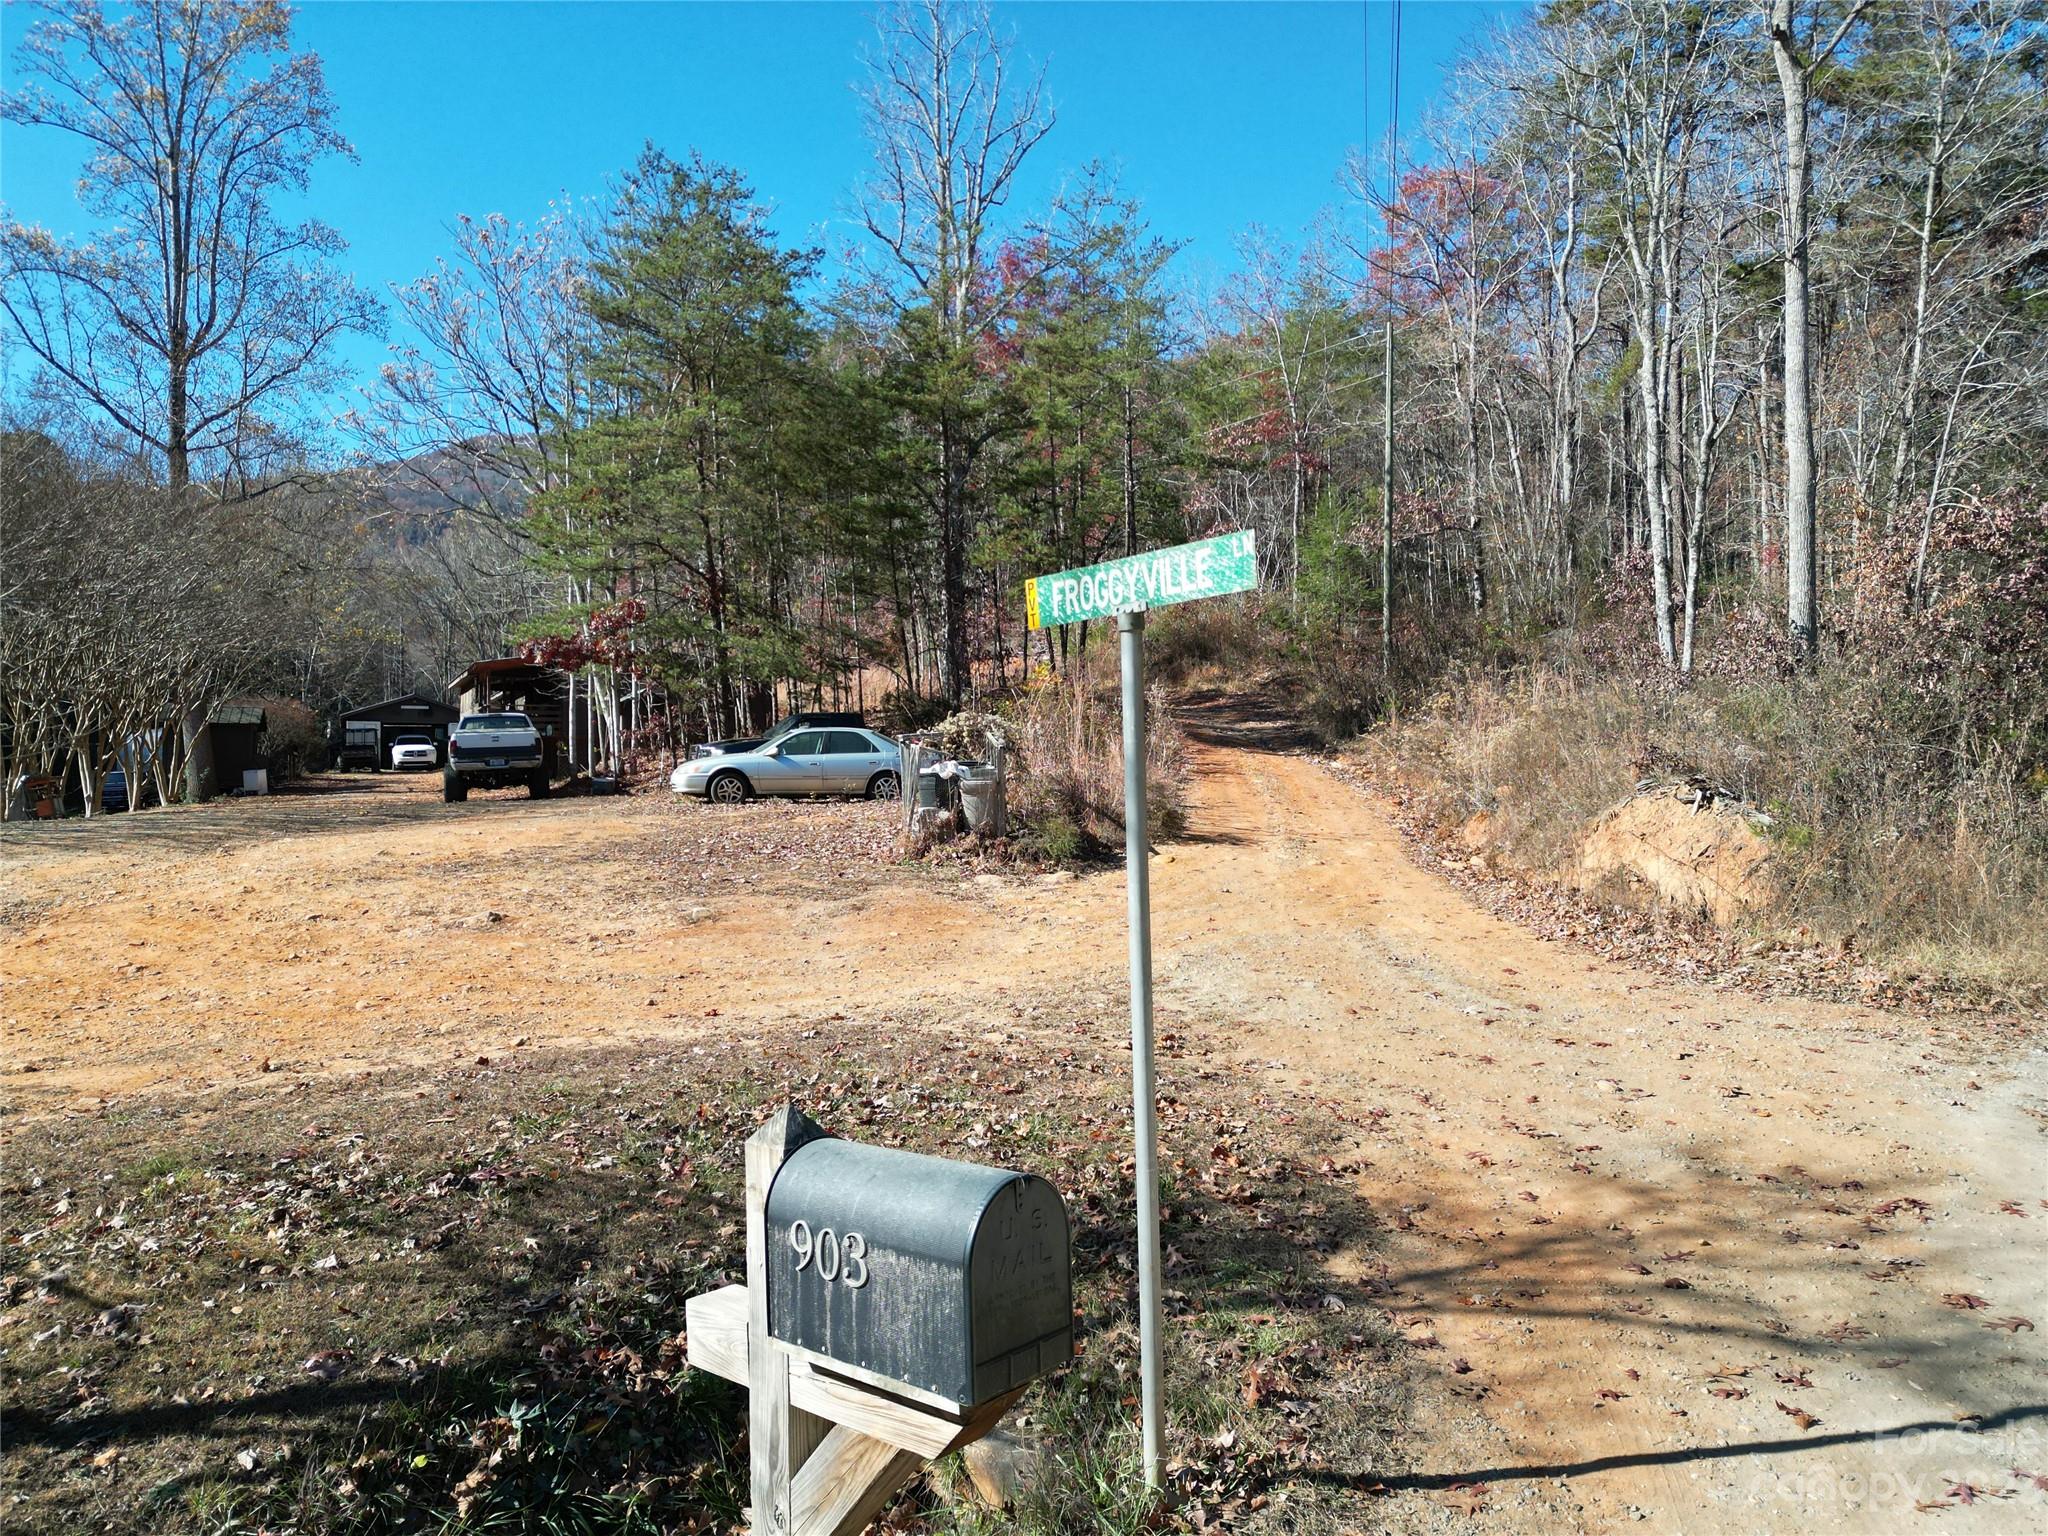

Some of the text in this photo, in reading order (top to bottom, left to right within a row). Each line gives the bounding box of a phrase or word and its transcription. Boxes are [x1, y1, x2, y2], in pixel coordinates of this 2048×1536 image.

[1027, 582, 1037, 628] PVT
[1051, 547, 1214, 618] FROGGYVILLE
[789, 1219, 869, 1289] 903
